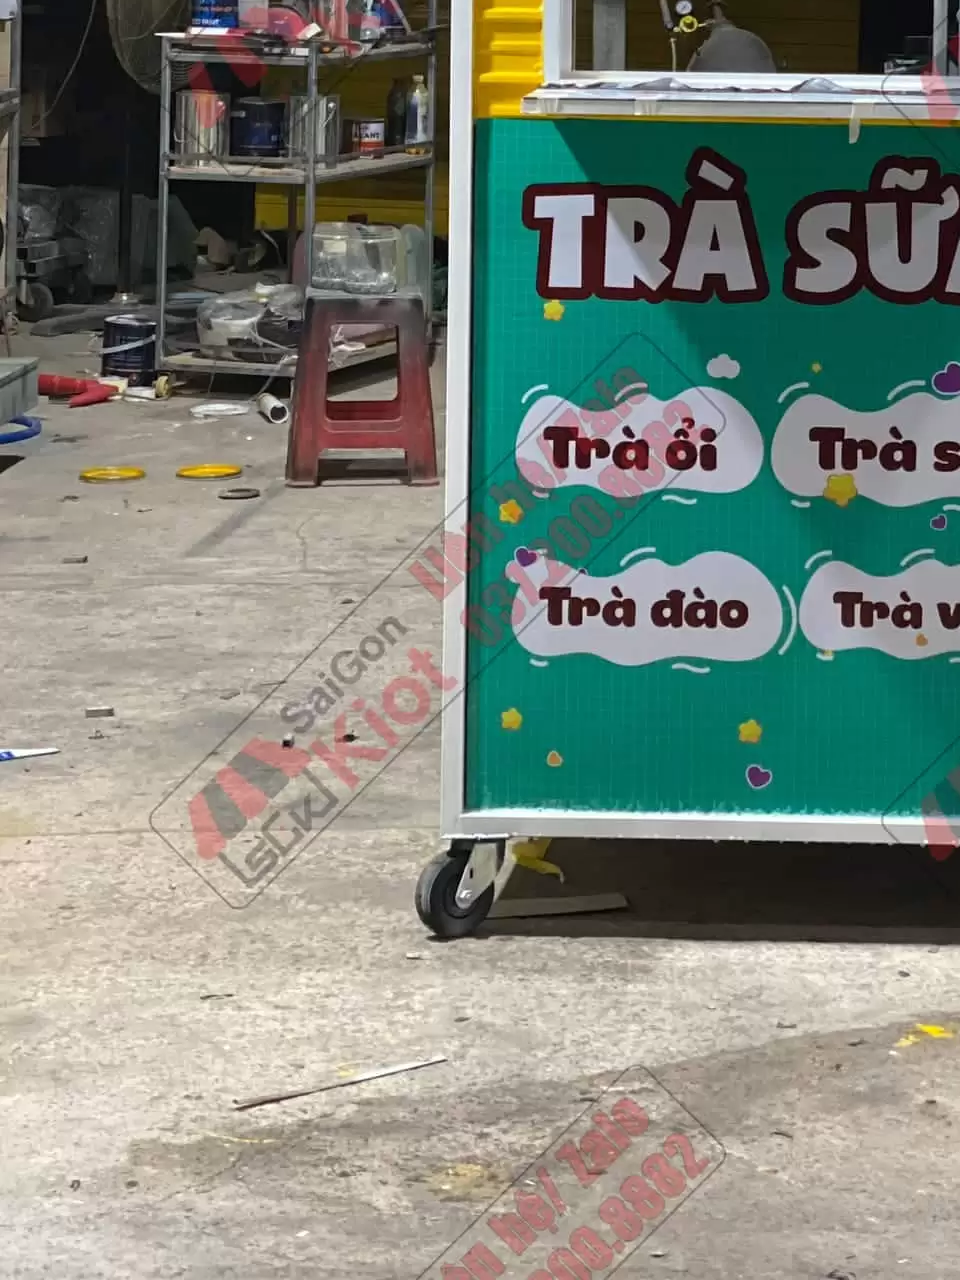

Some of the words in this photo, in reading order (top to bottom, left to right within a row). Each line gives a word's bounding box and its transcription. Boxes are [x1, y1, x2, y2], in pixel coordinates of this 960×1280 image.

[527, 152, 762, 297] TRÀ
[543, 425, 649, 471] Trà
[665, 417, 718, 471] ổi
[808, 426, 917, 472] Trà
[538, 586, 636, 628] Trà
[650, 587, 749, 629] đào
[833, 591, 924, 631] Trà
